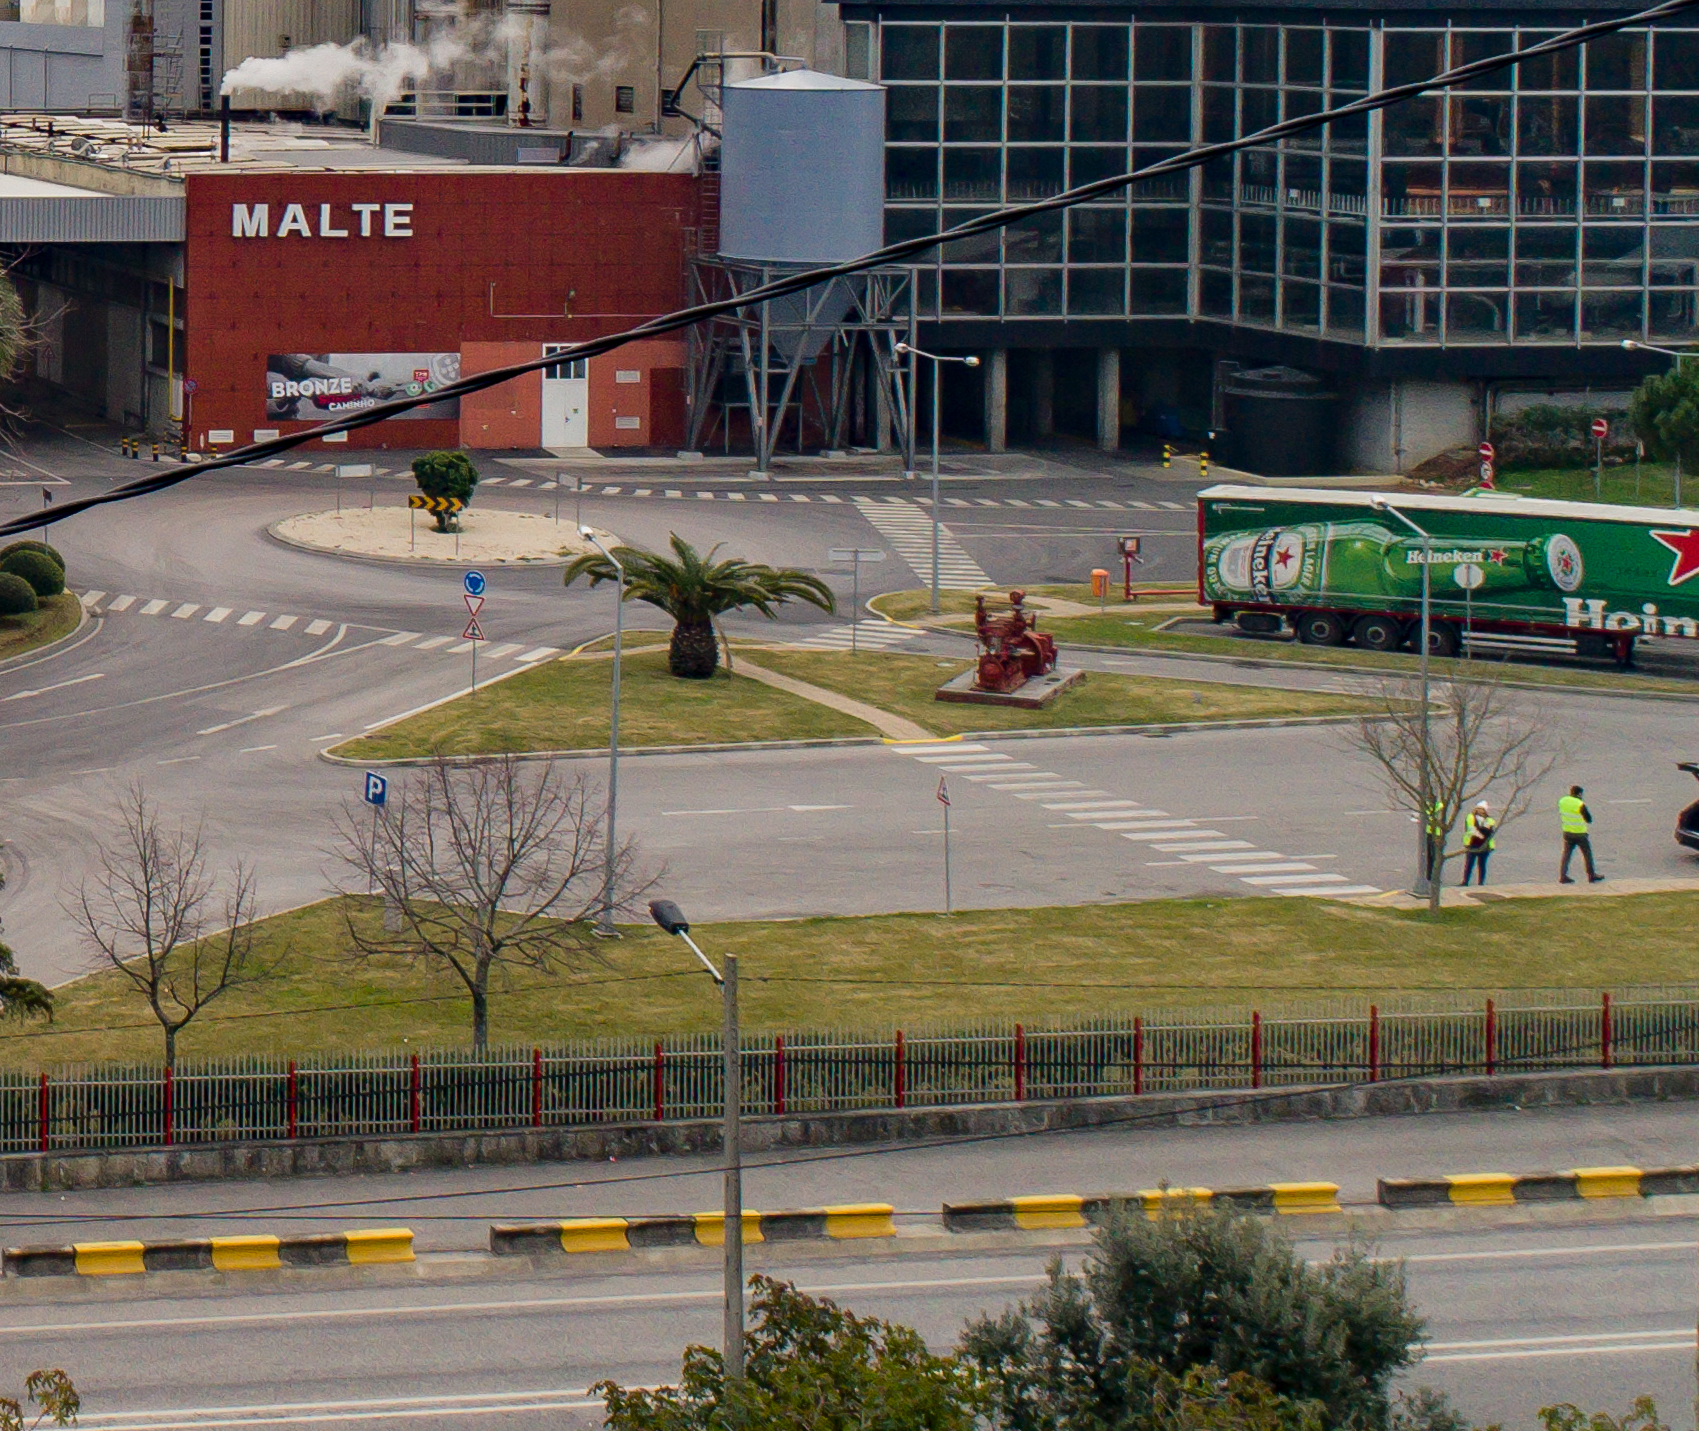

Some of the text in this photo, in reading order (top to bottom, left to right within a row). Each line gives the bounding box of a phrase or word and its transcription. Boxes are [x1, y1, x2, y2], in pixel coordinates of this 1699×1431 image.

[231, 202, 414, 238] MALTE
[271, 377, 353, 398] BRONZE
[368, 775, 383, 801] P
